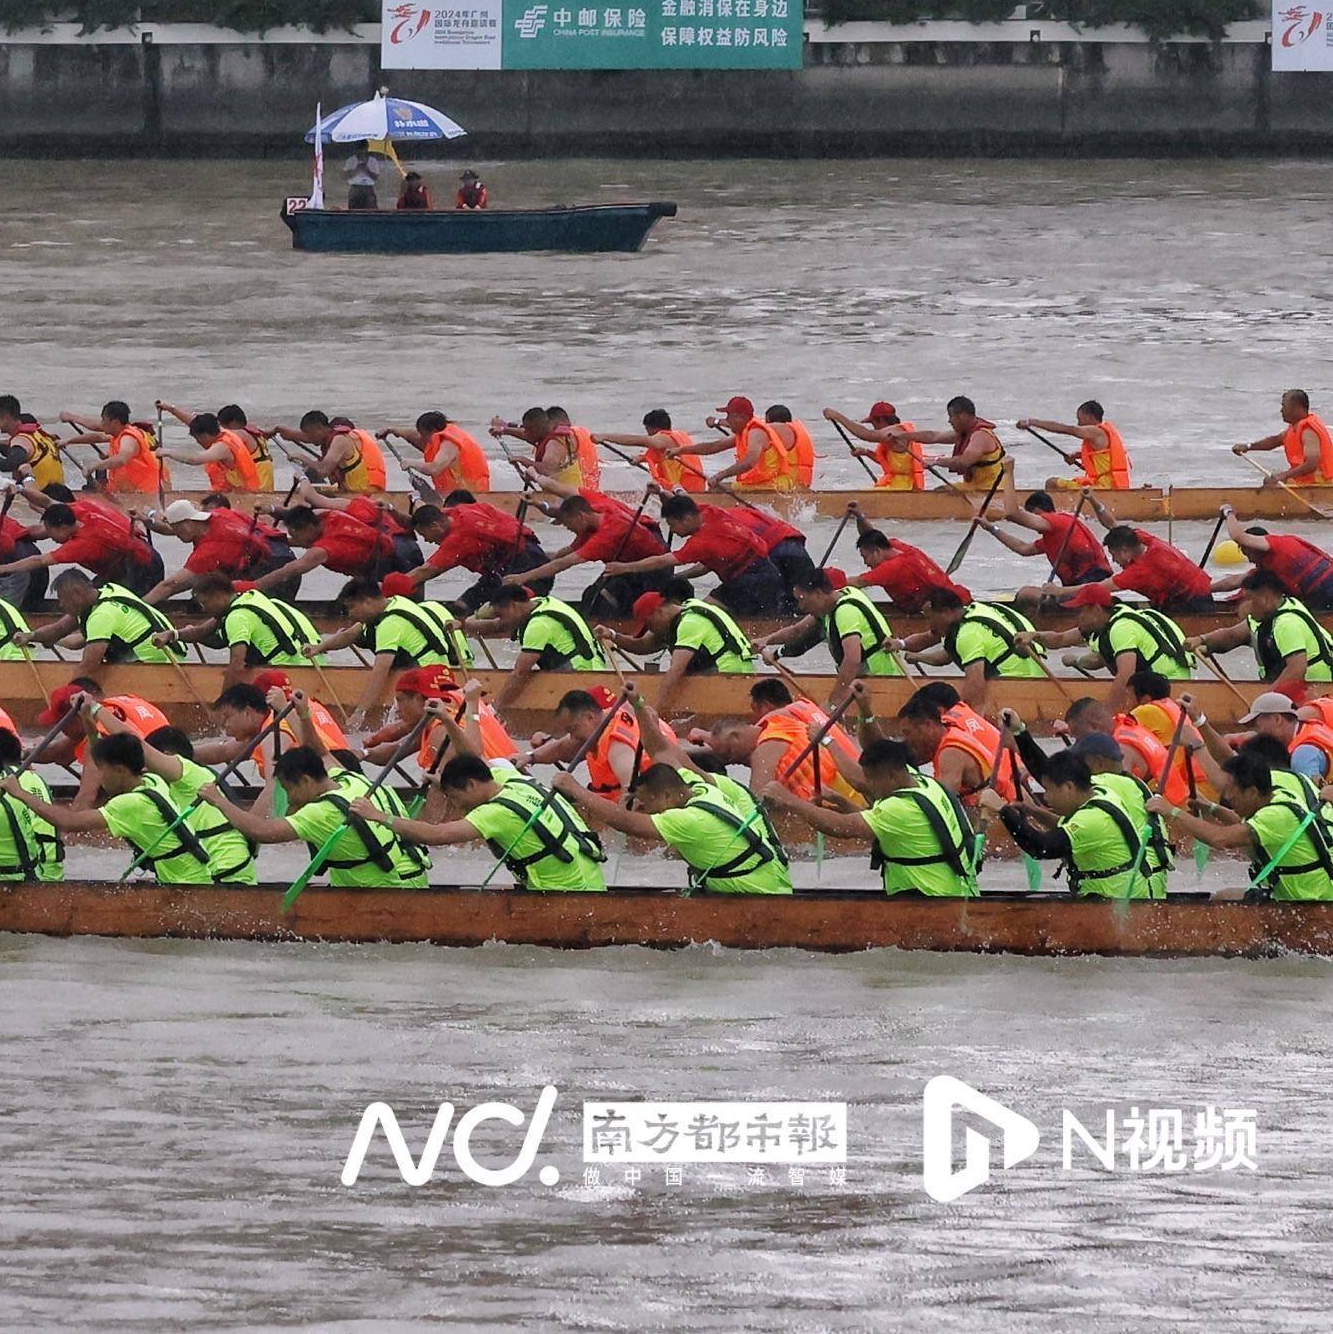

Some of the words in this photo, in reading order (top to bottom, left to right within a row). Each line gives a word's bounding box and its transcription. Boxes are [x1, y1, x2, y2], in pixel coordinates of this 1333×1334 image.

[434, 10, 489, 19] 2024年广州
[552, 7, 647, 28] 中邮保险
[553, 28, 577, 36] CHINA
[579, 28, 599, 36] POST
[661, 27, 789, 47] 保障权益防风险
[288, 199, 307, 214] 22
